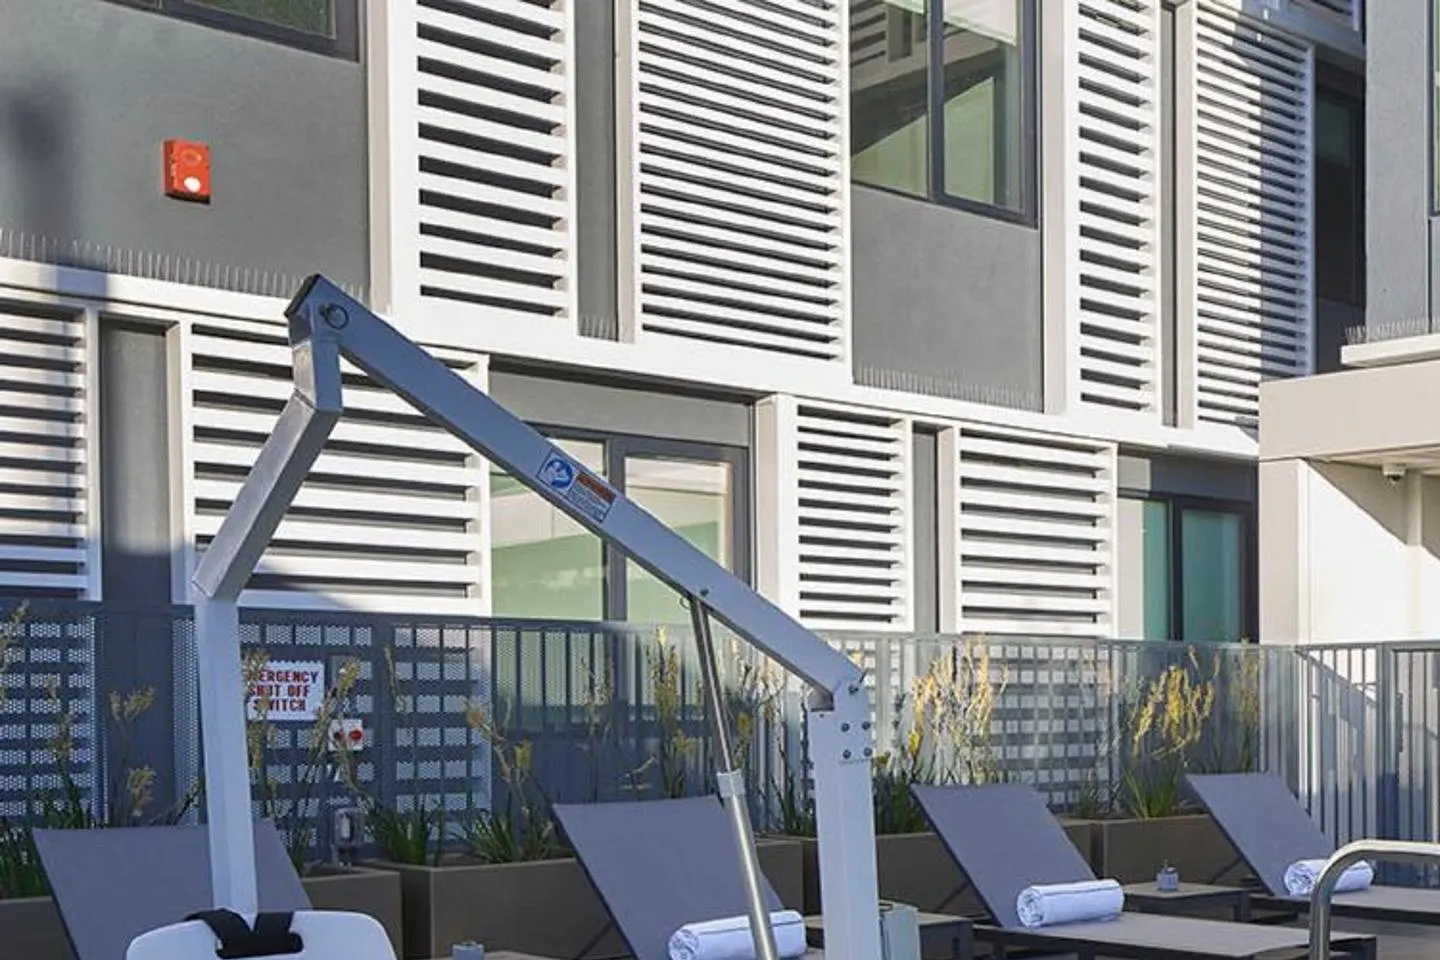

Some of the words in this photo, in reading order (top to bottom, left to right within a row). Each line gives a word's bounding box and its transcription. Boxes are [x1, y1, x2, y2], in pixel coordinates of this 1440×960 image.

[247, 670, 319, 684] ERGENCY
[287, 684, 311, 697] OFF
[253, 698, 306, 712] SITCH
